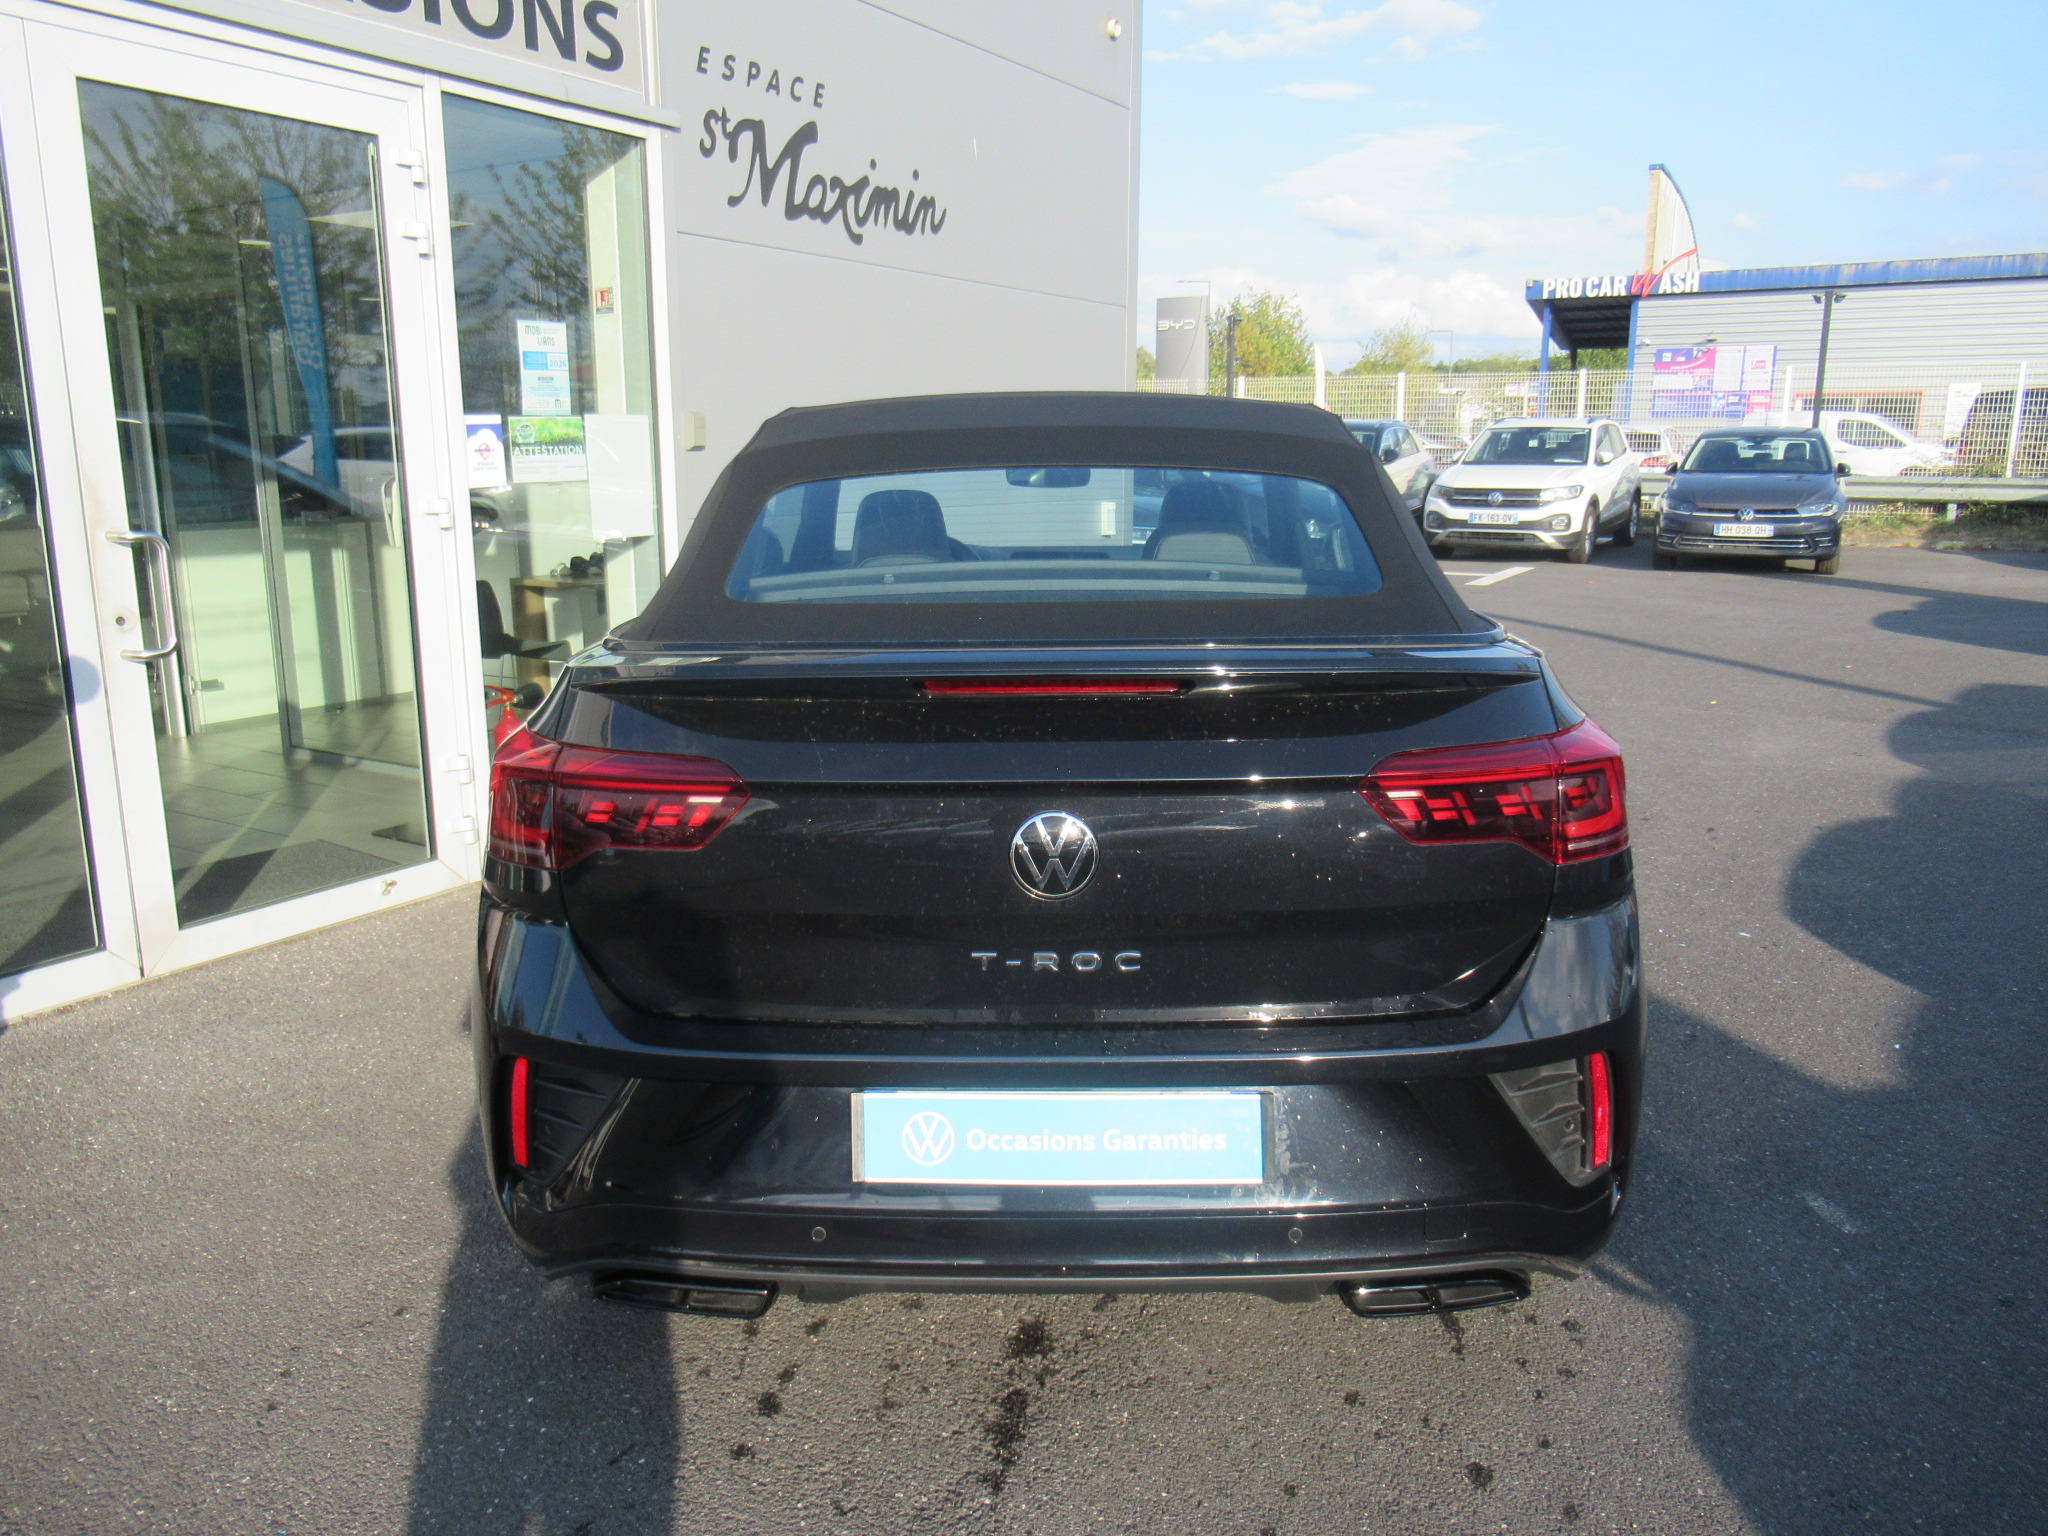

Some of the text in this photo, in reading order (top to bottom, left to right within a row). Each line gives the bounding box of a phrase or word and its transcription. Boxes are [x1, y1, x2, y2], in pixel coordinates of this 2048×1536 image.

[360, 0, 624, 72] ONS
[696, 46, 825, 109] ESPACE
[699, 106, 947, 246] St Maximin
[1542, 277, 1583, 299] PRO
[1585, 275, 1627, 298] CAR
[1157, 320, 1196, 331] BYD
[549, 359, 568, 368] 2026
[513, 445, 583, 456] ATTESTATION
[971, 951, 1142, 972] T-ROC
[966, 1128, 1096, 1152] Occasions
[1103, 1127, 1228, 1152] Garanties
